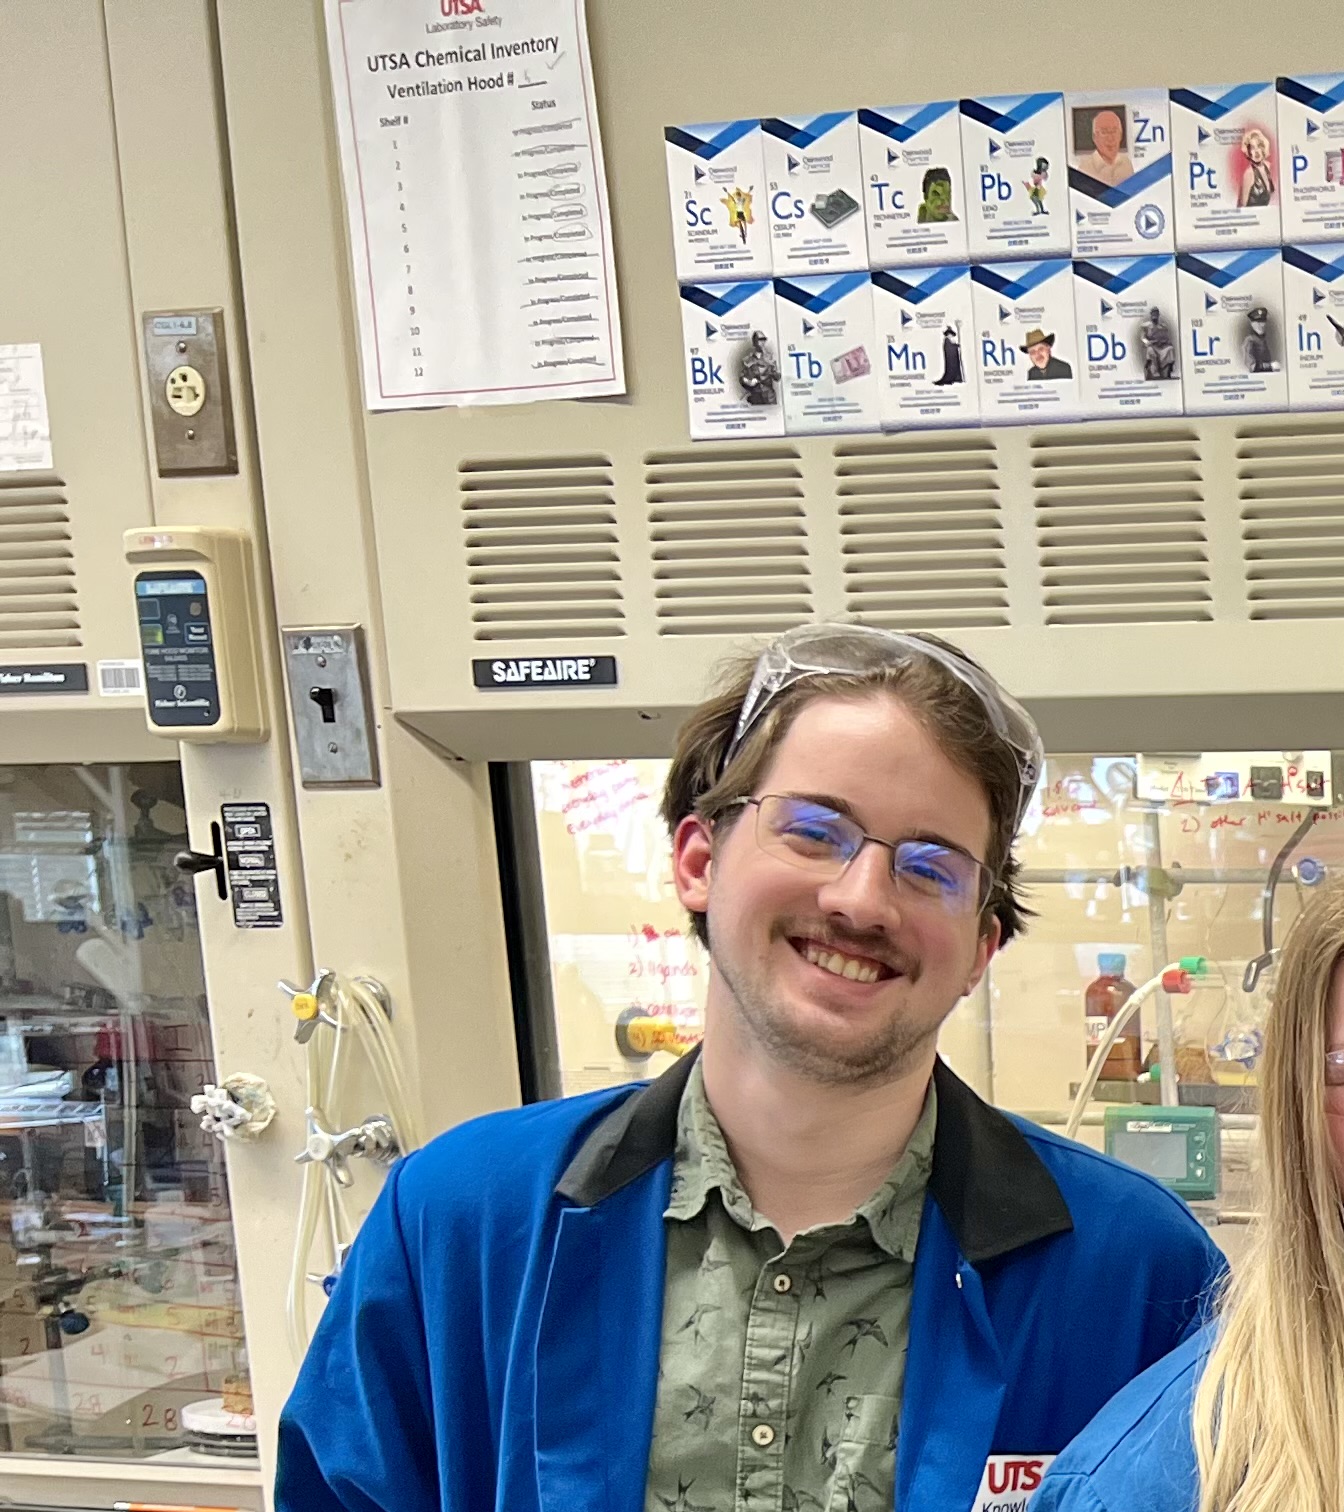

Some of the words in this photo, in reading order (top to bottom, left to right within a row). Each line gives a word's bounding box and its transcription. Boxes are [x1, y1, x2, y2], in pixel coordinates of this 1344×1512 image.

[441, 0, 485, 16] UTSA
[426, 19, 472, 34] Laboratory
[475, 15, 502, 28] Safety
[367, 54, 411, 72] UTSA
[416, 43, 486, 67] Chemical
[491, 36, 558, 59] Inventory
[387, 78, 463, 98] Ventilation
[467, 74, 503, 91] Hood
[532, 100, 556, 110] Status
[380, 117, 400, 127] Shelf
[1135, 119, 1165, 143] Zn
[1190, 163, 1217, 190] Pt
[1292, 155, 1308, 184] P
[871, 183, 905, 210] Tc
[981, 174, 1012, 201] Pb
[685, 200, 712, 226] Sc
[772, 192, 804, 220] Cs
[1088, 334, 1126, 361] Db
[1192, 329, 1220, 356] Lr
[1299, 324, 1321, 351] In
[789, 353, 822, 379] Tb
[887, 344, 926, 371] Mn
[982, 339, 1016, 367] Rh
[691, 357, 724, 385] Bk
[648, 961, 697, 985] ligands
[142, 1404, 178, 1431] 28
[988, 1461, 1044, 1494] UTS
